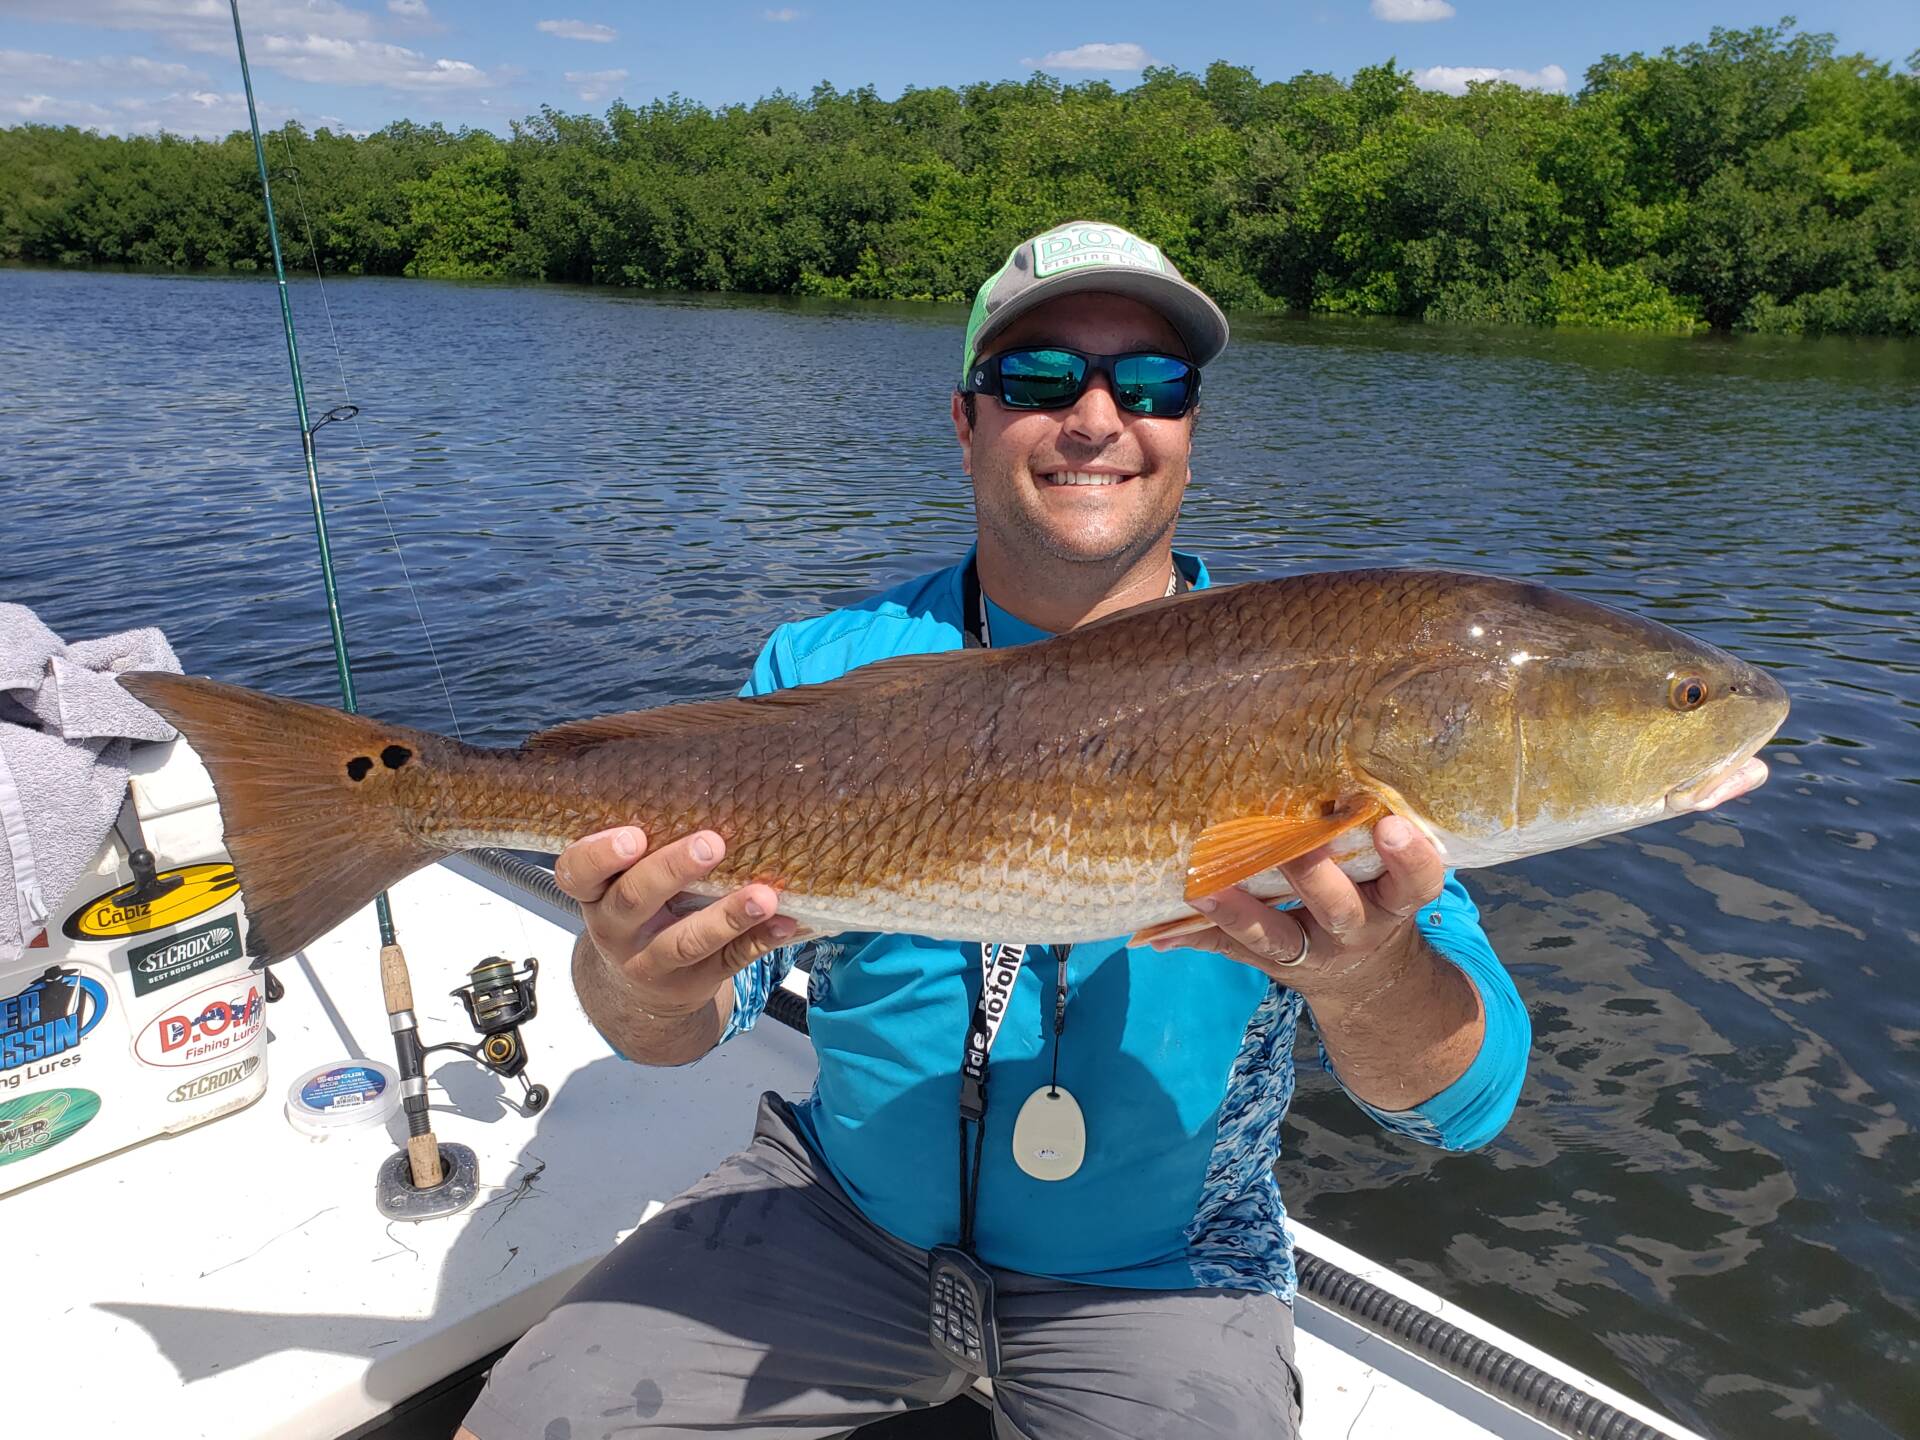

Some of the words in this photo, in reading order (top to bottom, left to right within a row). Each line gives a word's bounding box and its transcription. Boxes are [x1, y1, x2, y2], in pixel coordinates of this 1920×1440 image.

[1044, 254, 1110, 271] Fishing
[148, 973, 168, 984] BEST
[193, 960, 204, 968] ON
[0, 1013, 78, 1069] SSIN
[186, 1037, 230, 1060] Fishing
[233, 1022, 260, 1042] Lures
[27, 1054, 82, 1079] Lures
[8, 1132, 50, 1154] PRO
